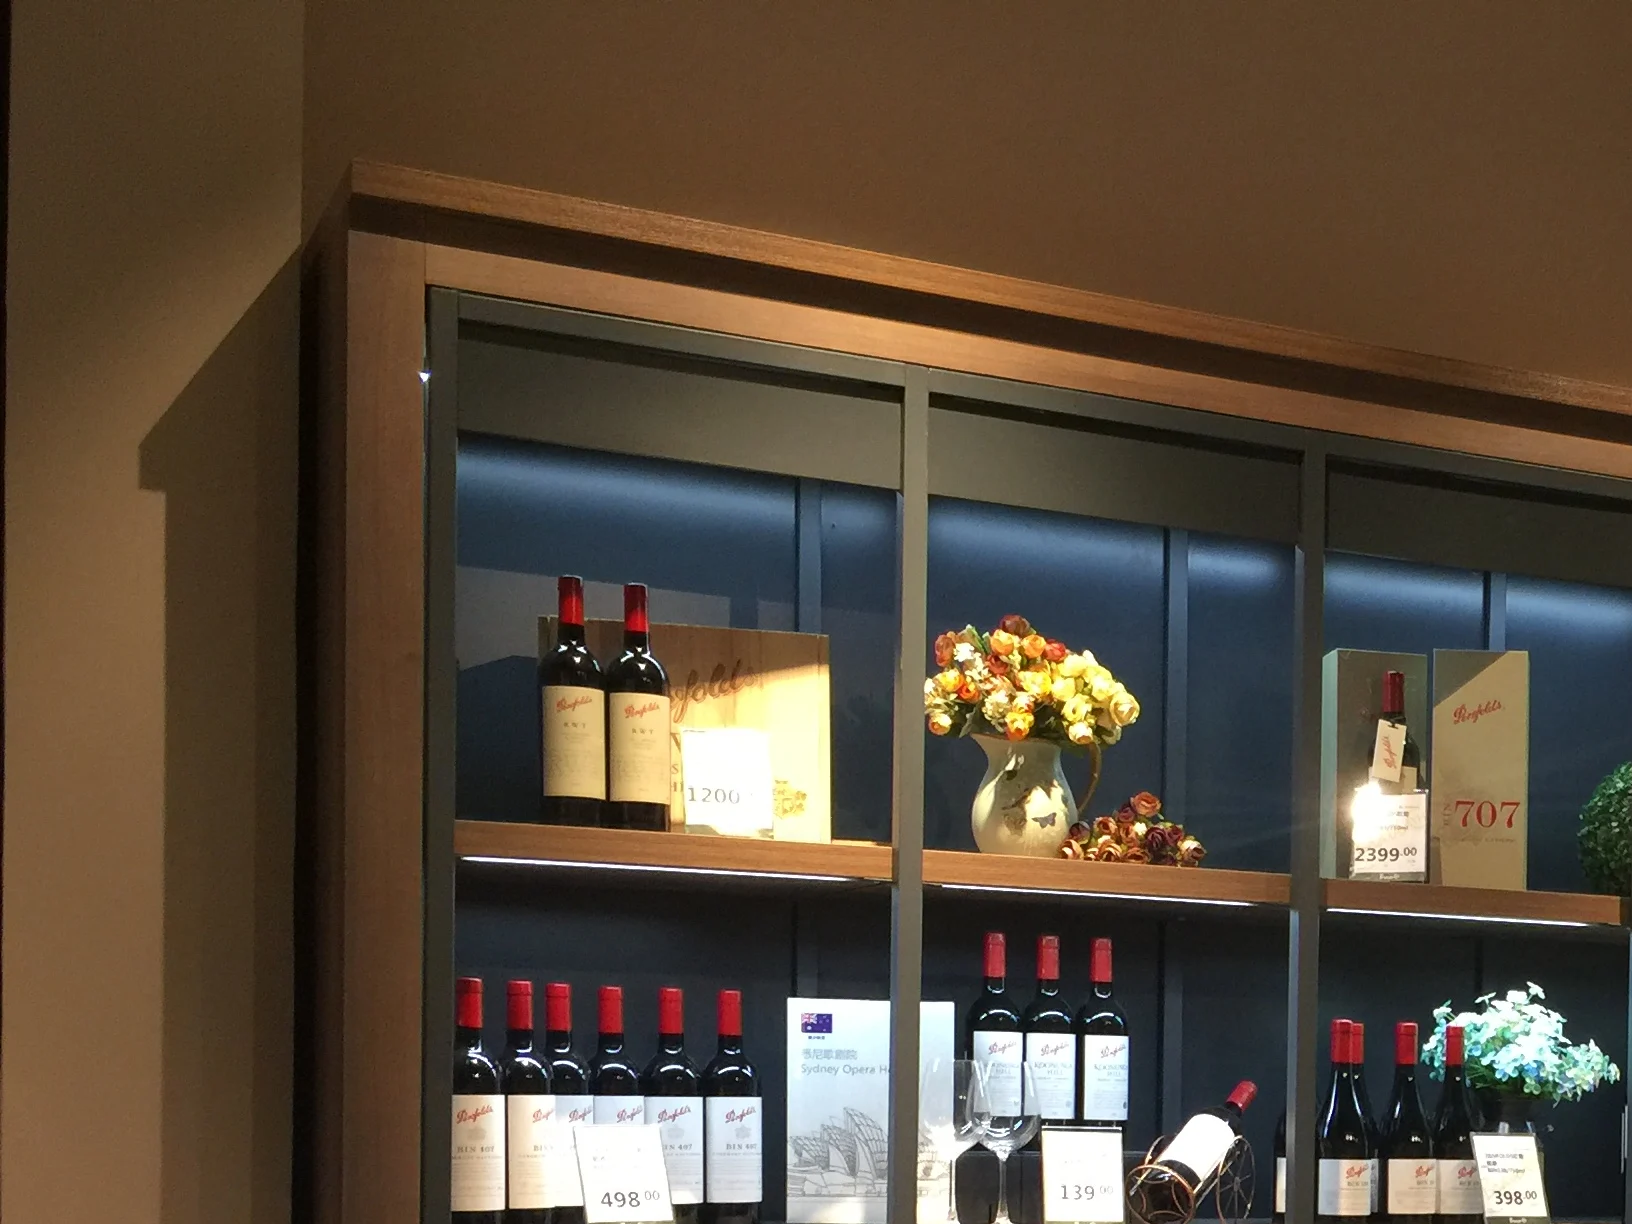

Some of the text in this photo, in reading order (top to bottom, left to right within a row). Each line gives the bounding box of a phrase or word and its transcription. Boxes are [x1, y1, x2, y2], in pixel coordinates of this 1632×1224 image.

[556, 696, 593, 713] Penfolds
[624, 702, 660, 718] Penfolds
[1453, 700, 1502, 725] Penfolds
[688, 787, 740, 804] 1200
[1455, 800, 1521, 828] 707
[1355, 847, 1417, 862] 2399.00
[801, 1063, 840, 1076] Sydney
[843, 1063, 876, 1076] Opera
[456, 1105, 494, 1124] Penfolds
[657, 1105, 692, 1124] Penfolds
[724, 1106, 757, 1124] Penfolds
[726, 1143, 743, 1151] BIN
[601, 1191, 640, 1208] 498
[1061, 1185, 1095, 1200] 139
